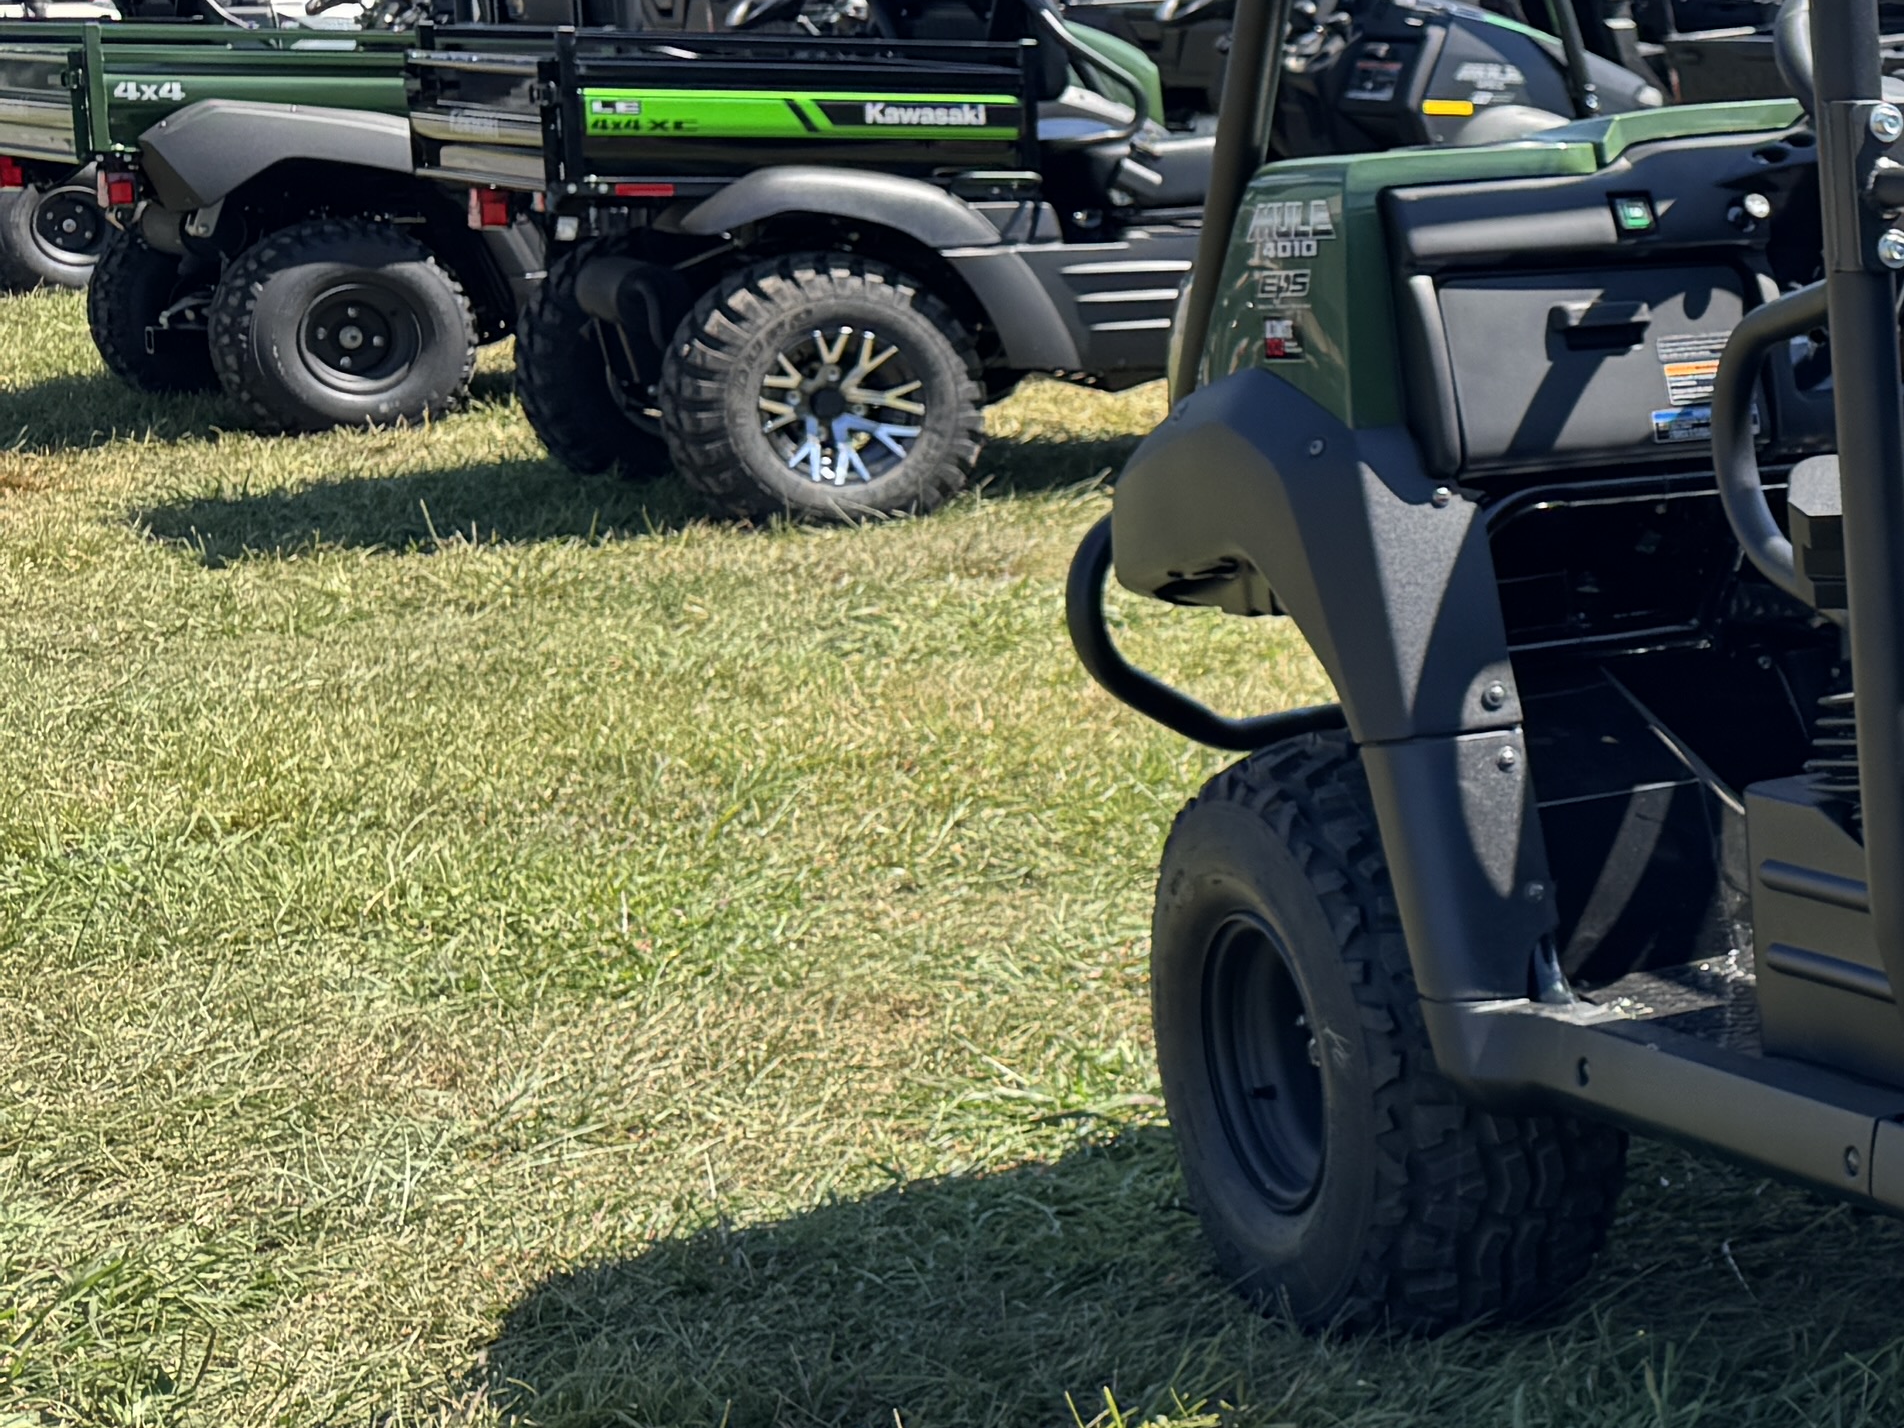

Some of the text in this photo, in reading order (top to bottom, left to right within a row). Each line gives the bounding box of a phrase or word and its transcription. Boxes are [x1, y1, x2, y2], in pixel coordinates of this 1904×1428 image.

[113, 81, 186, 101] 4x4
[591, 99, 641, 115] LE
[864, 102, 987, 126] Kawasaki
[1246, 199, 1337, 243] MULE
[1262, 239, 1317, 258] 4010
